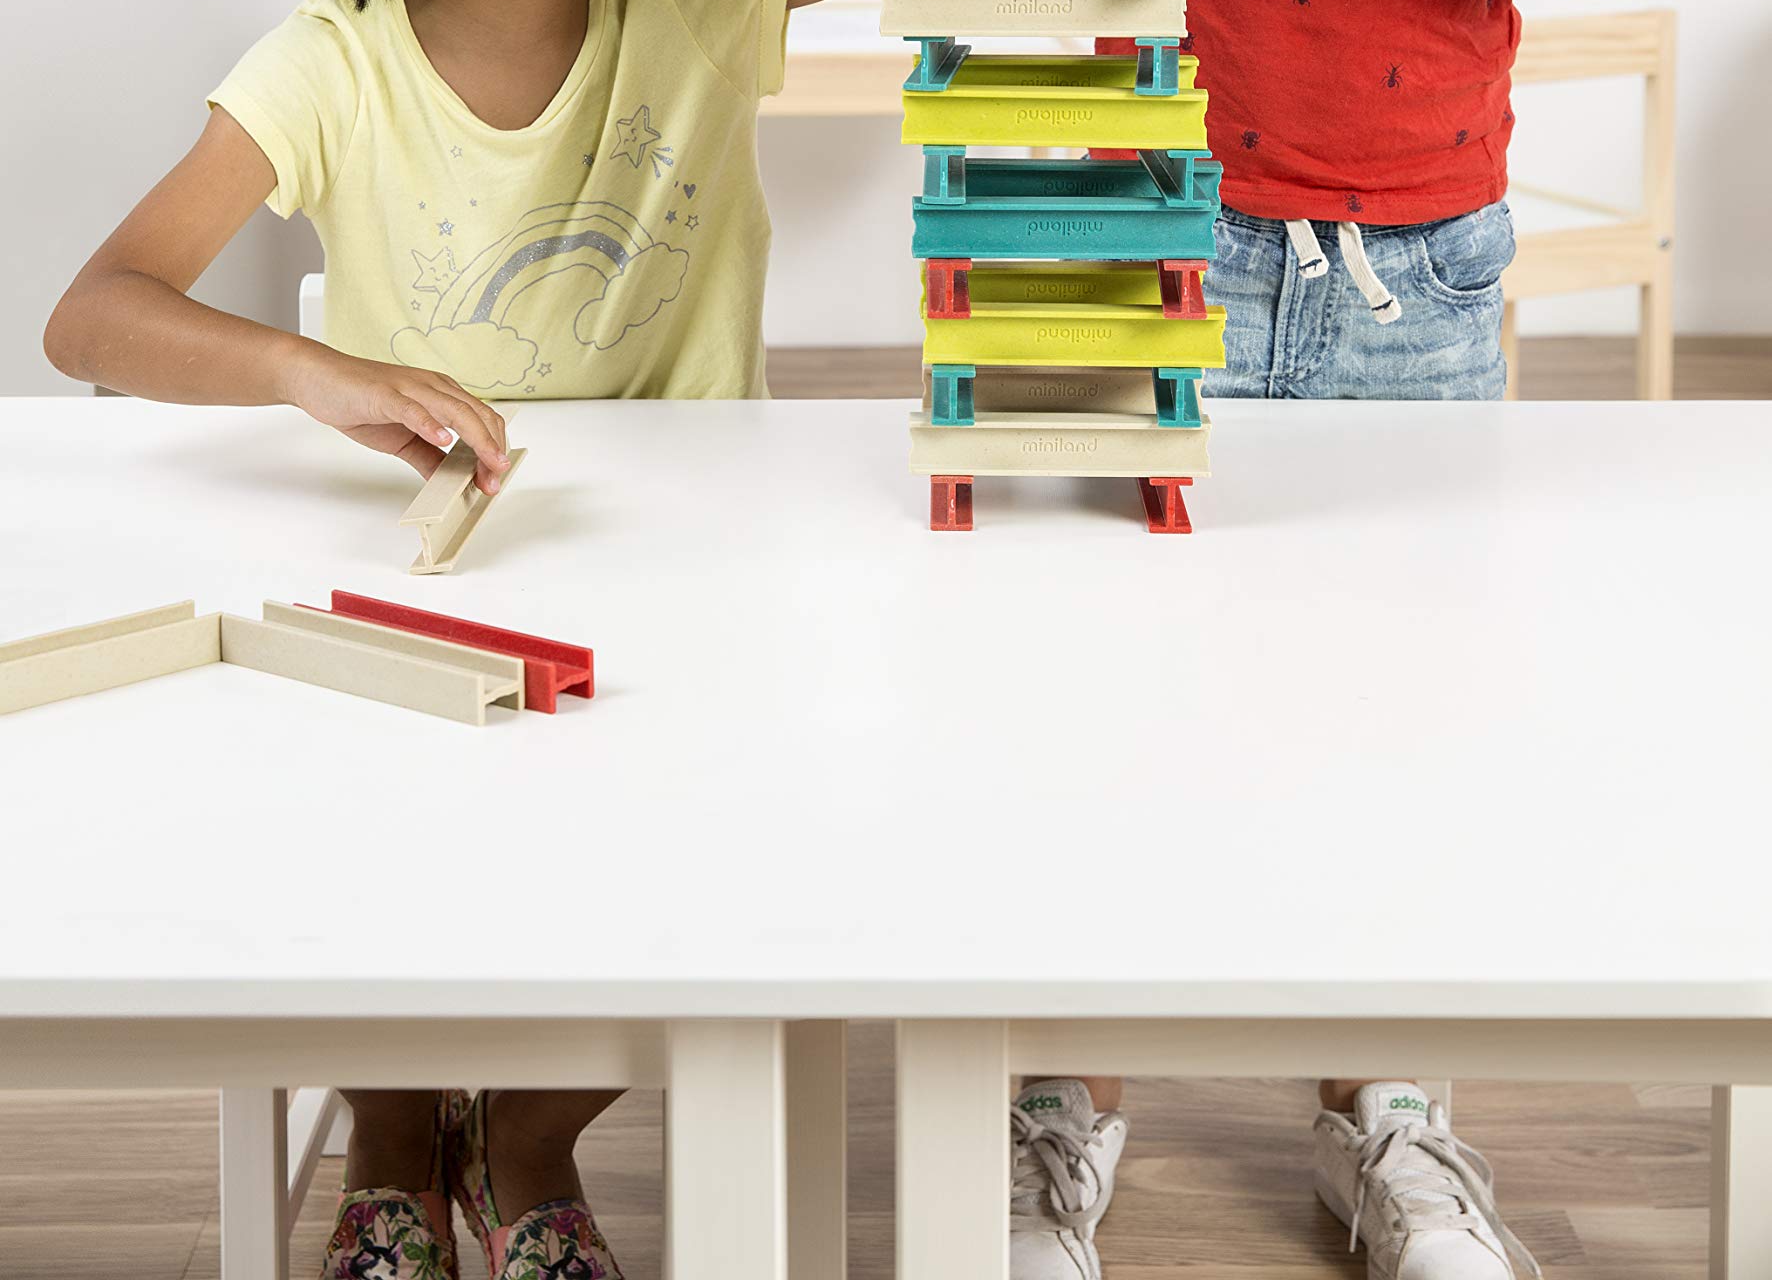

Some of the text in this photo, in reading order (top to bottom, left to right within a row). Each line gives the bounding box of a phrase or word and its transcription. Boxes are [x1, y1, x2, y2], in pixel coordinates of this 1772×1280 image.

[996, 0, 1073, 14] miniland
[1016, 109, 1094, 125] miniland
[1043, 181, 1116, 196] miniland
[1027, 221, 1104, 236] miniland
[1026, 283, 1098, 298] miniland
[1036, 328, 1113, 343] miniland
[1028, 383, 1099, 397] miniland
[1022, 437, 1098, 452] miniland
[1390, 1095, 1428, 1113] adida
